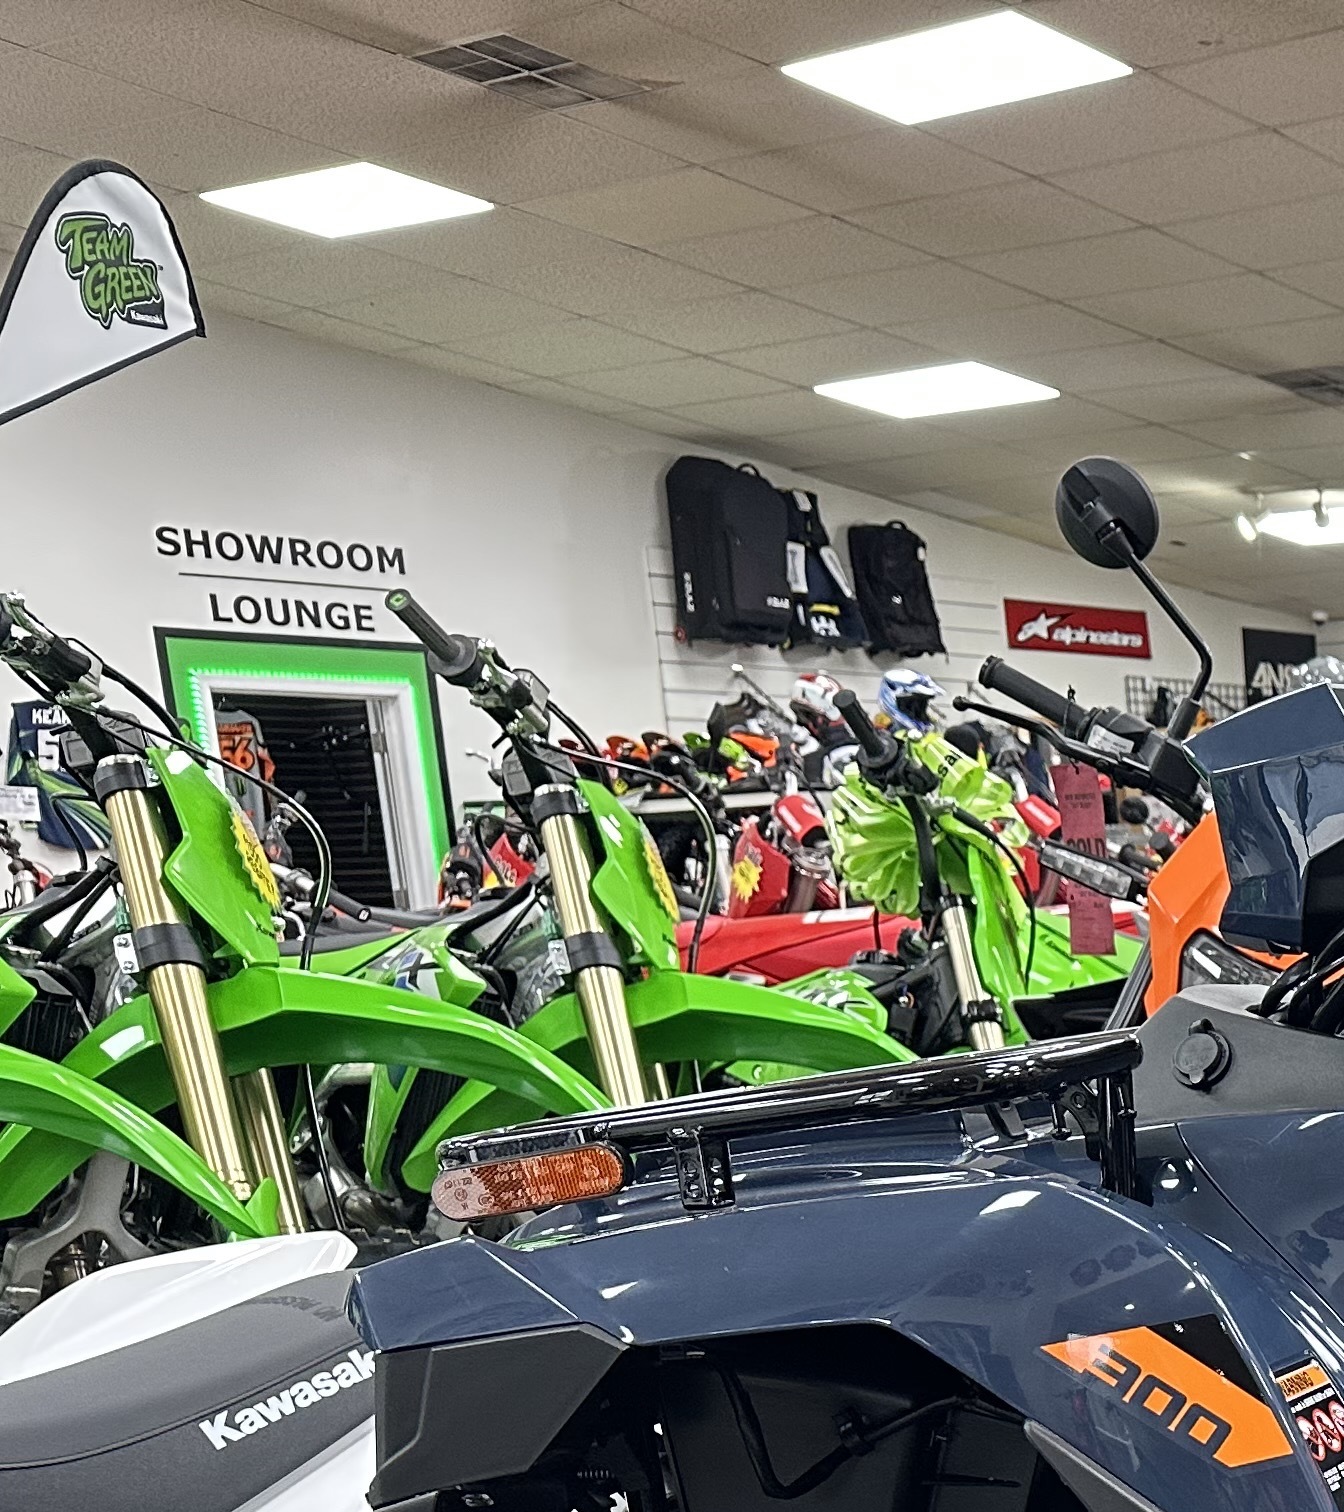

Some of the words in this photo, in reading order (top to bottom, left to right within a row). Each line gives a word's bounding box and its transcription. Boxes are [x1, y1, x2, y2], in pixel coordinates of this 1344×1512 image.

[59, 217, 129, 269] TEAM
[84, 262, 160, 319] GREEN
[155, 526, 406, 576] SHOWROOM
[209, 593, 375, 632] LOUNGE
[199, 1348, 377, 1451] Kawasak
[1090, 1341, 1232, 1456] 300
